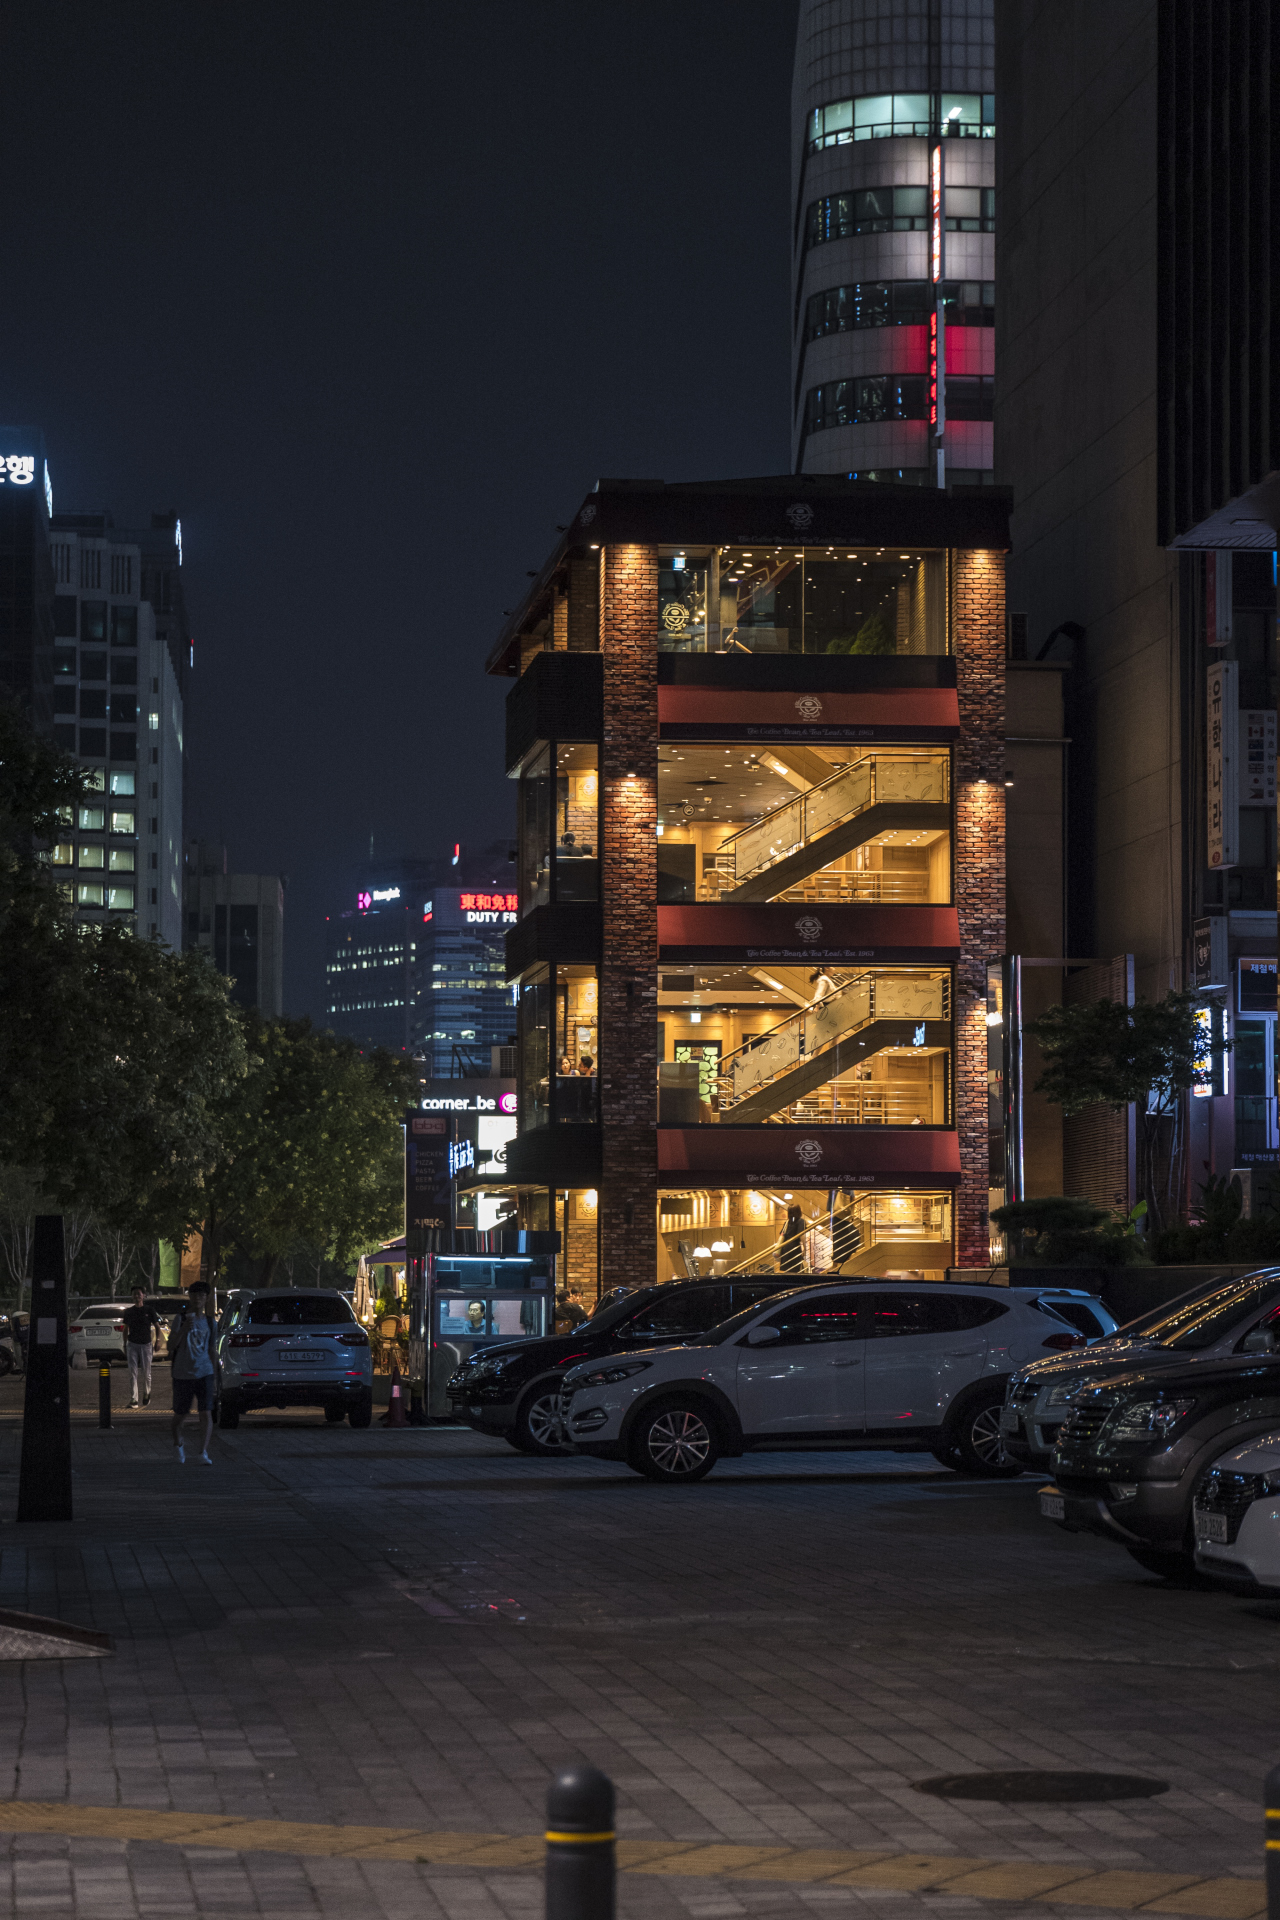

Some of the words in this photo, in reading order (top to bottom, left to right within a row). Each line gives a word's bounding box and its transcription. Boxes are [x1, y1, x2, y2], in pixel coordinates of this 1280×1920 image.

[0, 454, 35, 485] 행
[467, 911, 499, 923] DUTY
[746, 948, 759, 958] The
[782, 948, 802, 958] Bean
[809, 948, 822, 958] Tea
[858, 948, 875, 958] 1963
[422, 1095, 496, 1110] corner_be
[746, 1173, 759, 1182] The
[760, 1173, 781, 1182] Coffee
[782, 1173, 802, 1182] Bean
[809, 1173, 822, 1182] Tea
[858, 1173, 875, 1182] 1963
[302, 1352, 320, 1360] 4579
